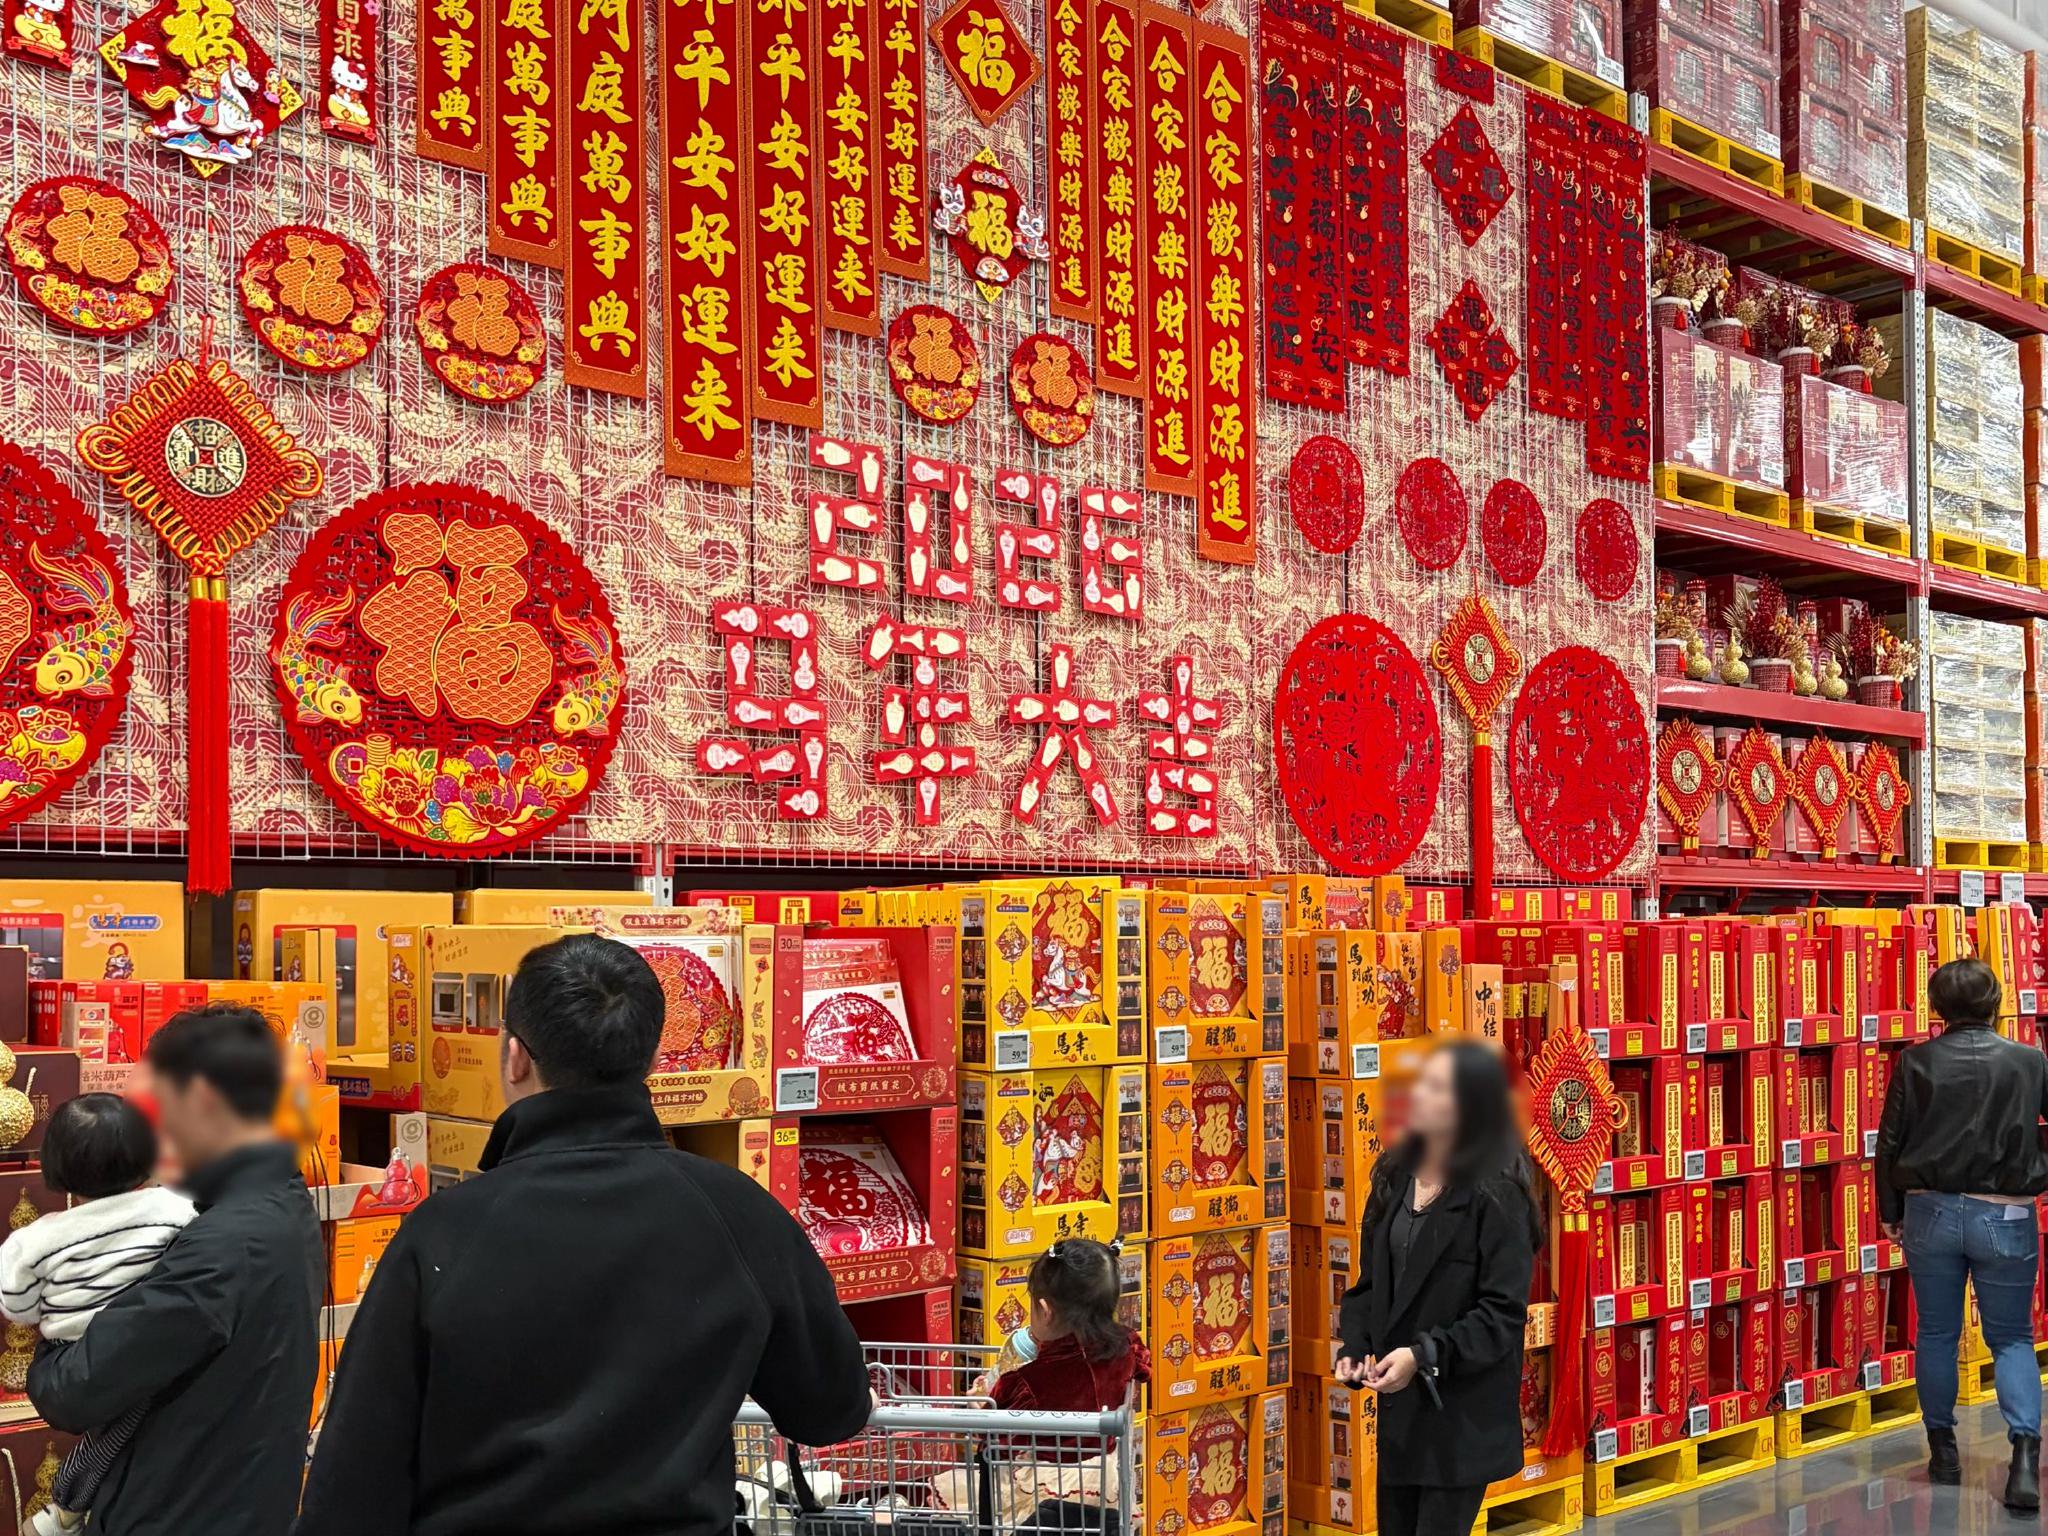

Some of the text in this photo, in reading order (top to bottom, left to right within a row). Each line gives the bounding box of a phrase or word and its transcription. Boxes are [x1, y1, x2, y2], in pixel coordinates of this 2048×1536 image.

[161, 0, 248, 68] 福
[957, 10, 1015, 96] 福
[47, 186, 139, 283] 福
[966, 190, 1013, 259] 福
[274, 235, 354, 325] 福
[447, 272, 521, 356] 福
[909, 314, 961, 383] 福
[1030, 341, 1077, 408] 福
[810, 435, 1144, 620] 2026
[360, 512, 554, 725] 福
[696, 602, 1222, 838] 马年大吉
[1047, 889, 1090, 949] 福
[1197, 937, 1232, 990] 福
[1200, 1102, 1232, 1157] 福
[1203, 1274, 1238, 1329] 福
[1201, 1440, 1236, 1497] 福
